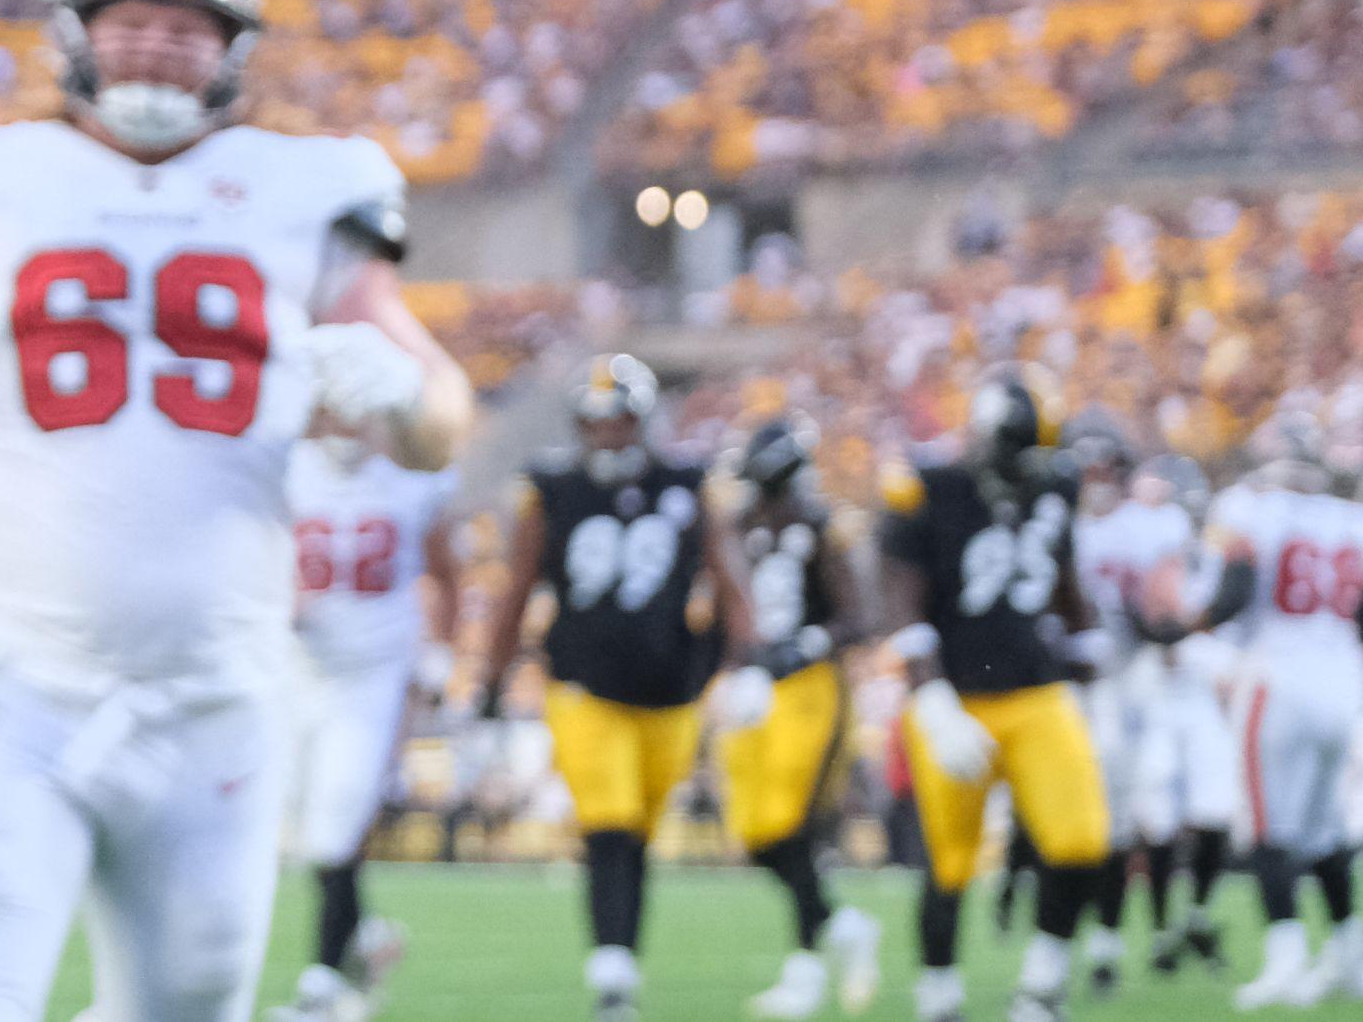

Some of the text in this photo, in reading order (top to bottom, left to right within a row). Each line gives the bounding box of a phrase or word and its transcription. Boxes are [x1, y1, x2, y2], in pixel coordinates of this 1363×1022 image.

[12, 246, 269, 438] 69
[293, 517, 399, 594] 62
[564, 512, 679, 612] 99
